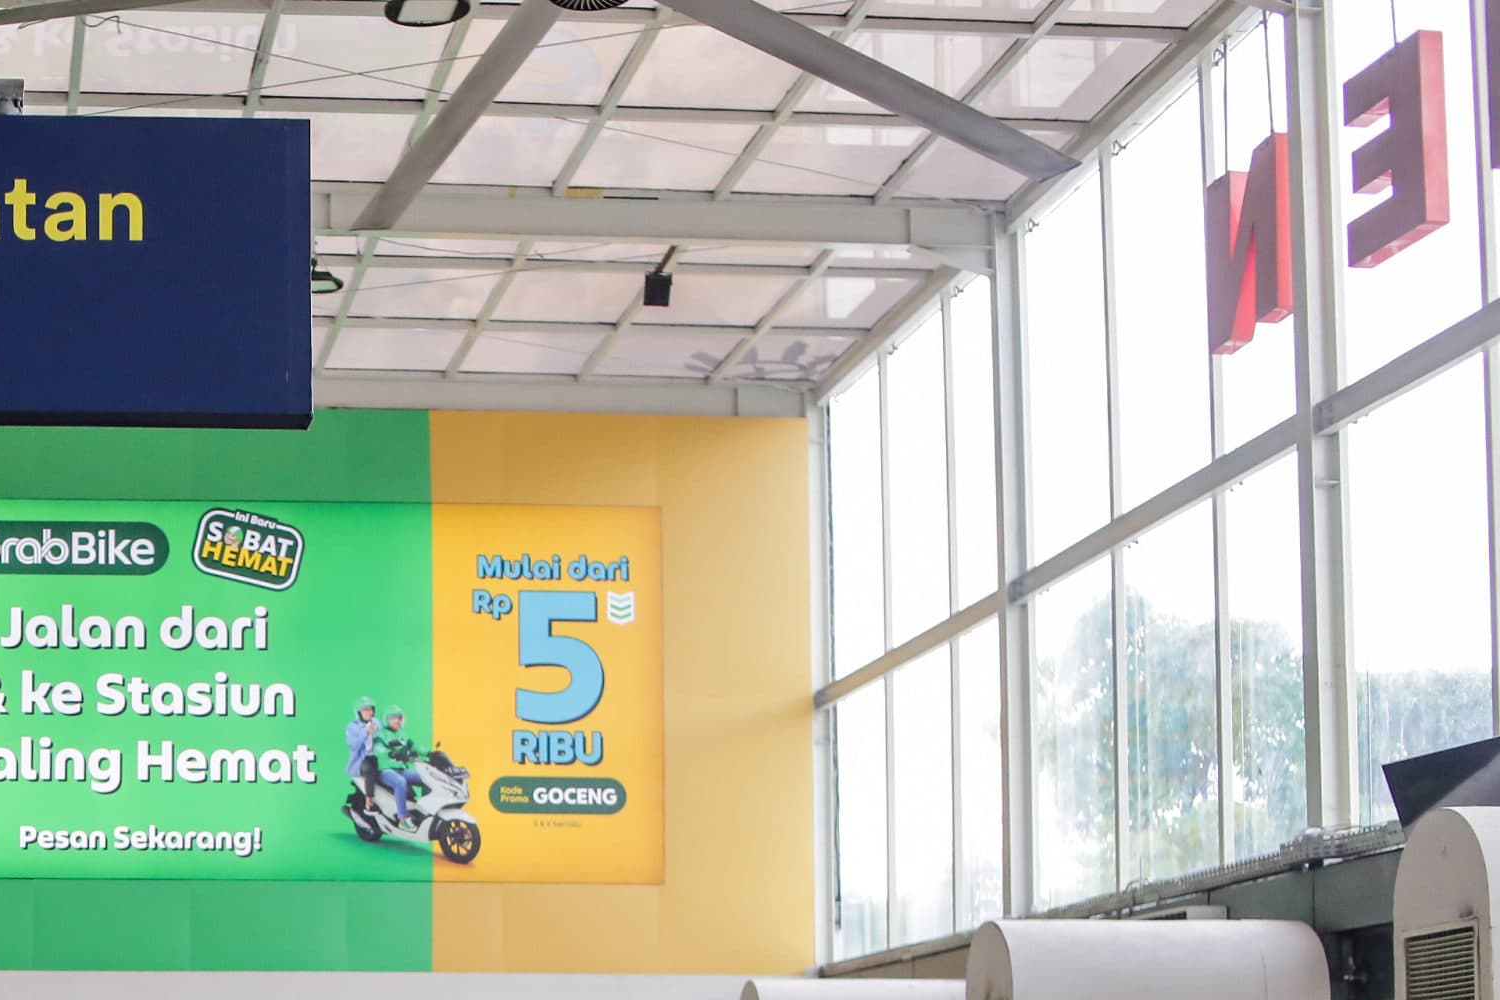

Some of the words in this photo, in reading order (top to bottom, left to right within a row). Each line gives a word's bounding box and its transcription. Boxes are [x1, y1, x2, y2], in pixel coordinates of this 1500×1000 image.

[206, 521, 294, 558] SBAT
[202, 540, 293, 577] HEMAT
[476, 554, 561, 580] Mulai
[567, 555, 630, 582] dari
[472, 588, 513, 620] Rp
[1, 604, 146, 649] Jalan
[159, 605, 269, 650] dari
[515, 590, 605, 725] 5
[21, 670, 83, 715] ke
[96, 671, 295, 717] Stasiun
[137, 740, 317, 783] Hemat
[512, 730, 604, 767] RIBU
[533, 787, 618, 806] GOCENG
[19, 826, 107, 849] Pesan
[114, 825, 262, 856] Sekarang!
